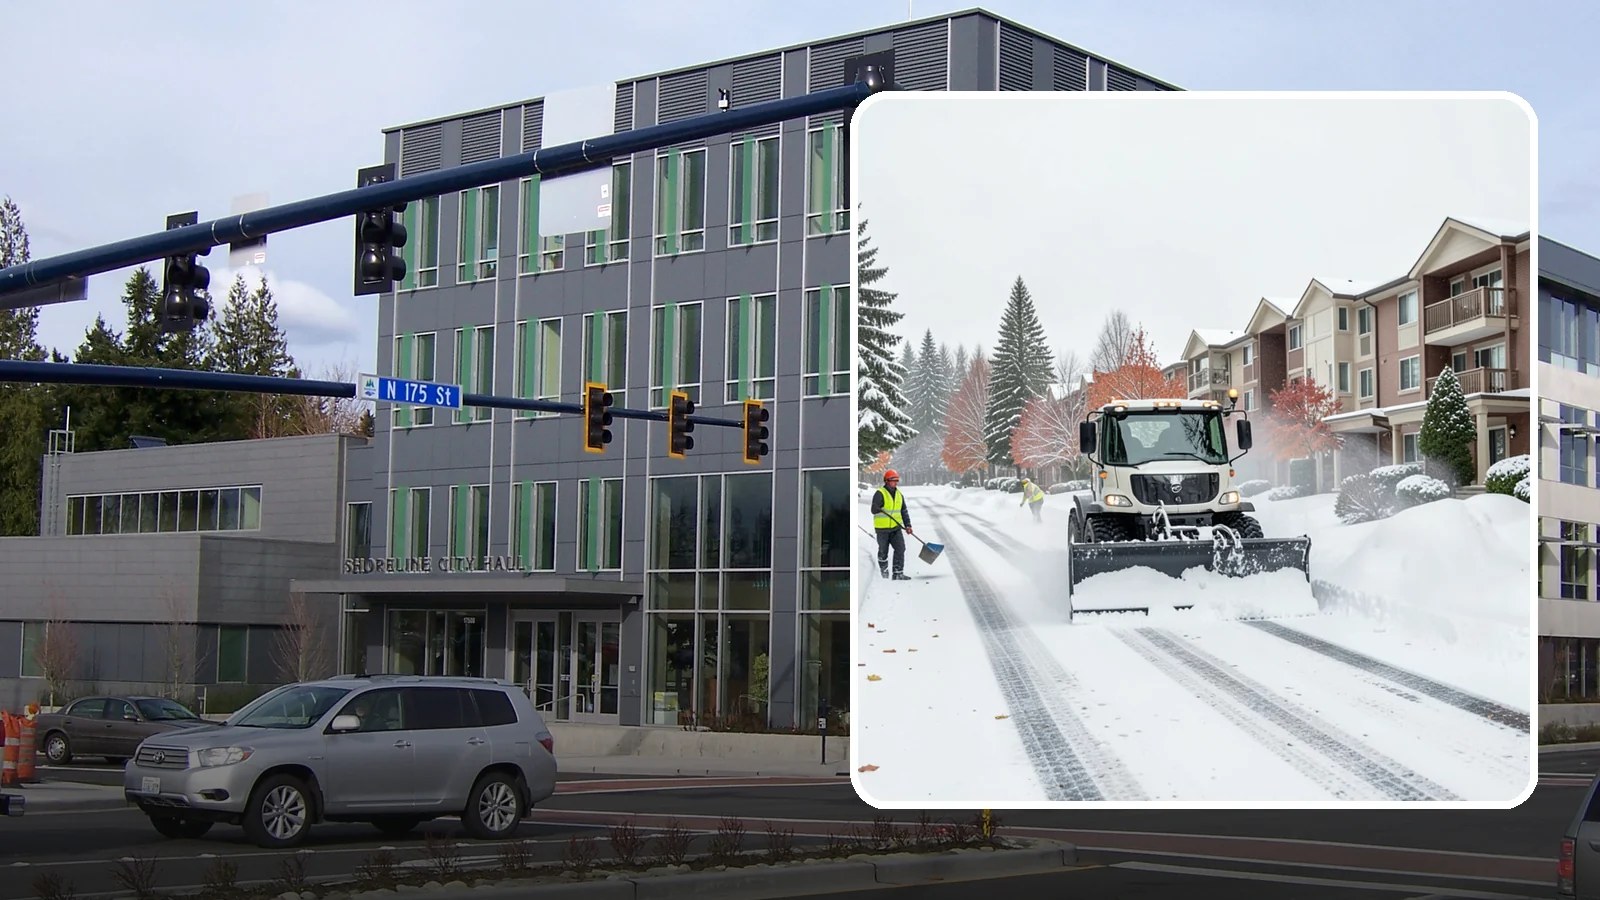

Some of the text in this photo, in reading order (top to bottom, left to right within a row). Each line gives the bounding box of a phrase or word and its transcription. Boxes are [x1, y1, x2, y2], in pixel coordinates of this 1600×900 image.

[387, 380, 451, 406] N 175 St
[344, 555, 525, 574] SHORELINE CITY HALL
